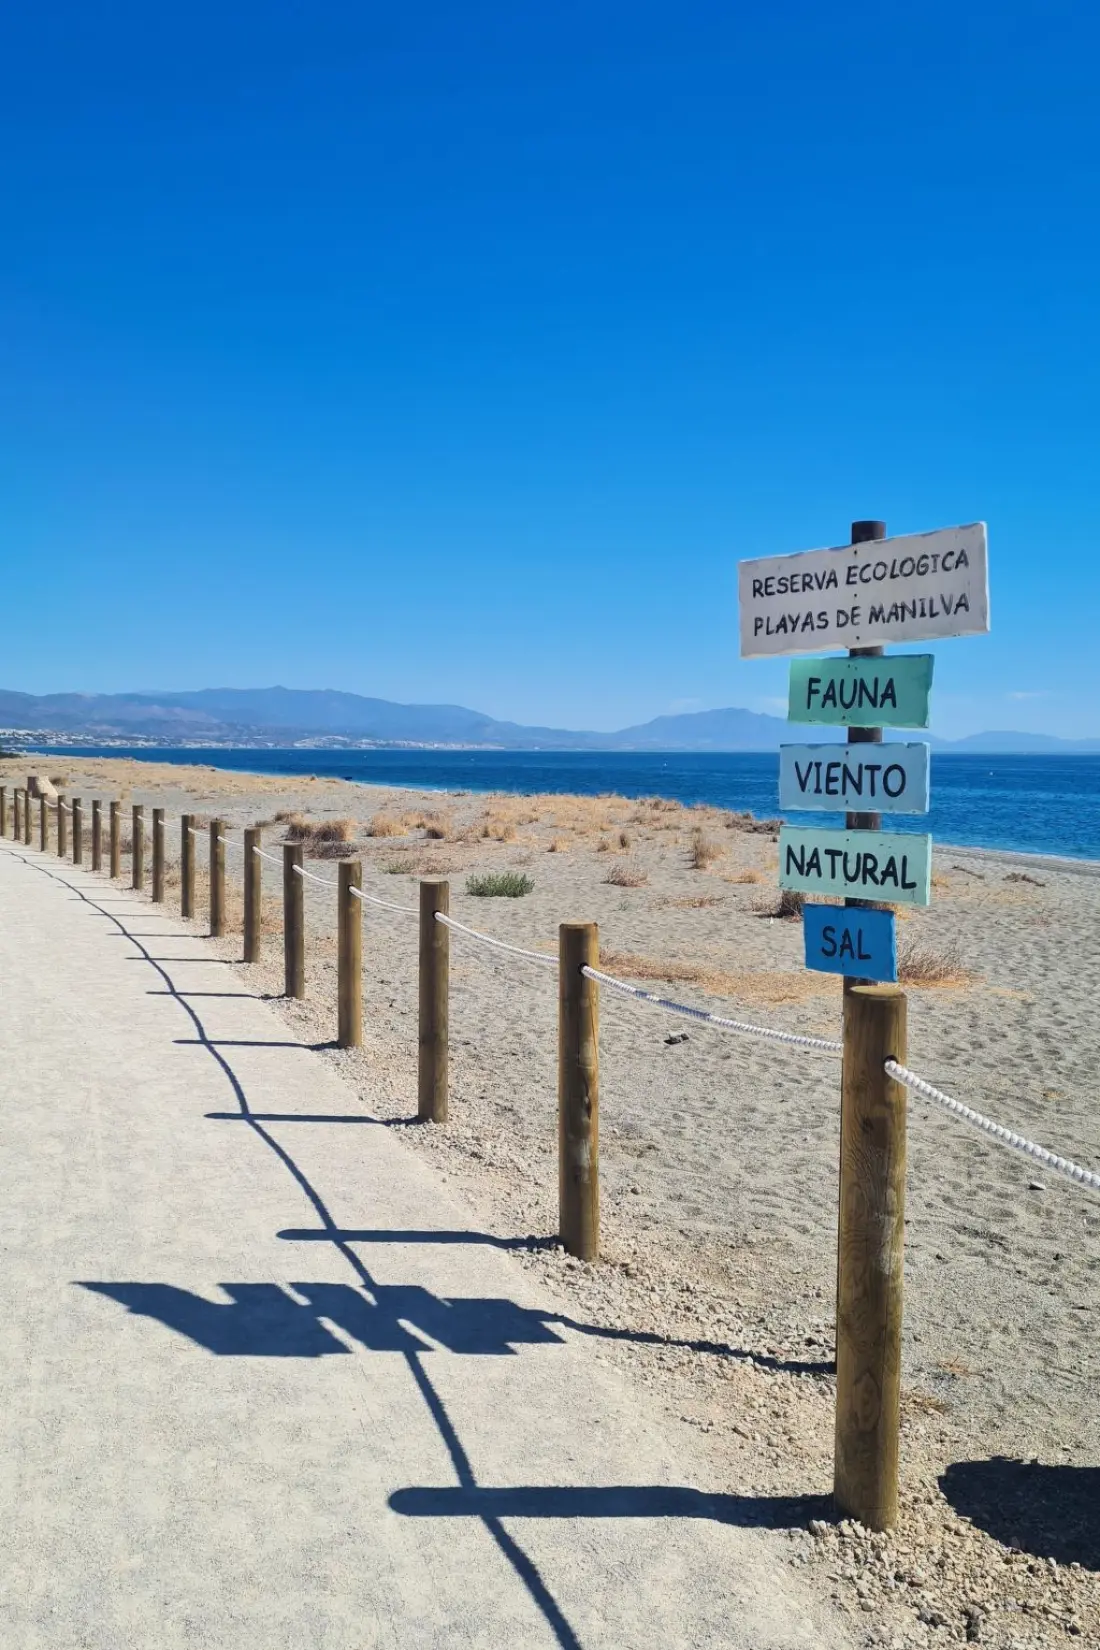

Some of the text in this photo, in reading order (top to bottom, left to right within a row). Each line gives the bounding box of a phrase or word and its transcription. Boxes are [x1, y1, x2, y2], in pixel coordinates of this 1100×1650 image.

[752, 549, 970, 598] RESERVA ECOLOGICA
[753, 593, 970, 637] PLAYAS DE MANILVA
[806, 677, 897, 709] FAUNA
[794, 761, 906, 797] VIENTO
[786, 844, 917, 890] NATURAL
[821, 925, 872, 960] SAL
